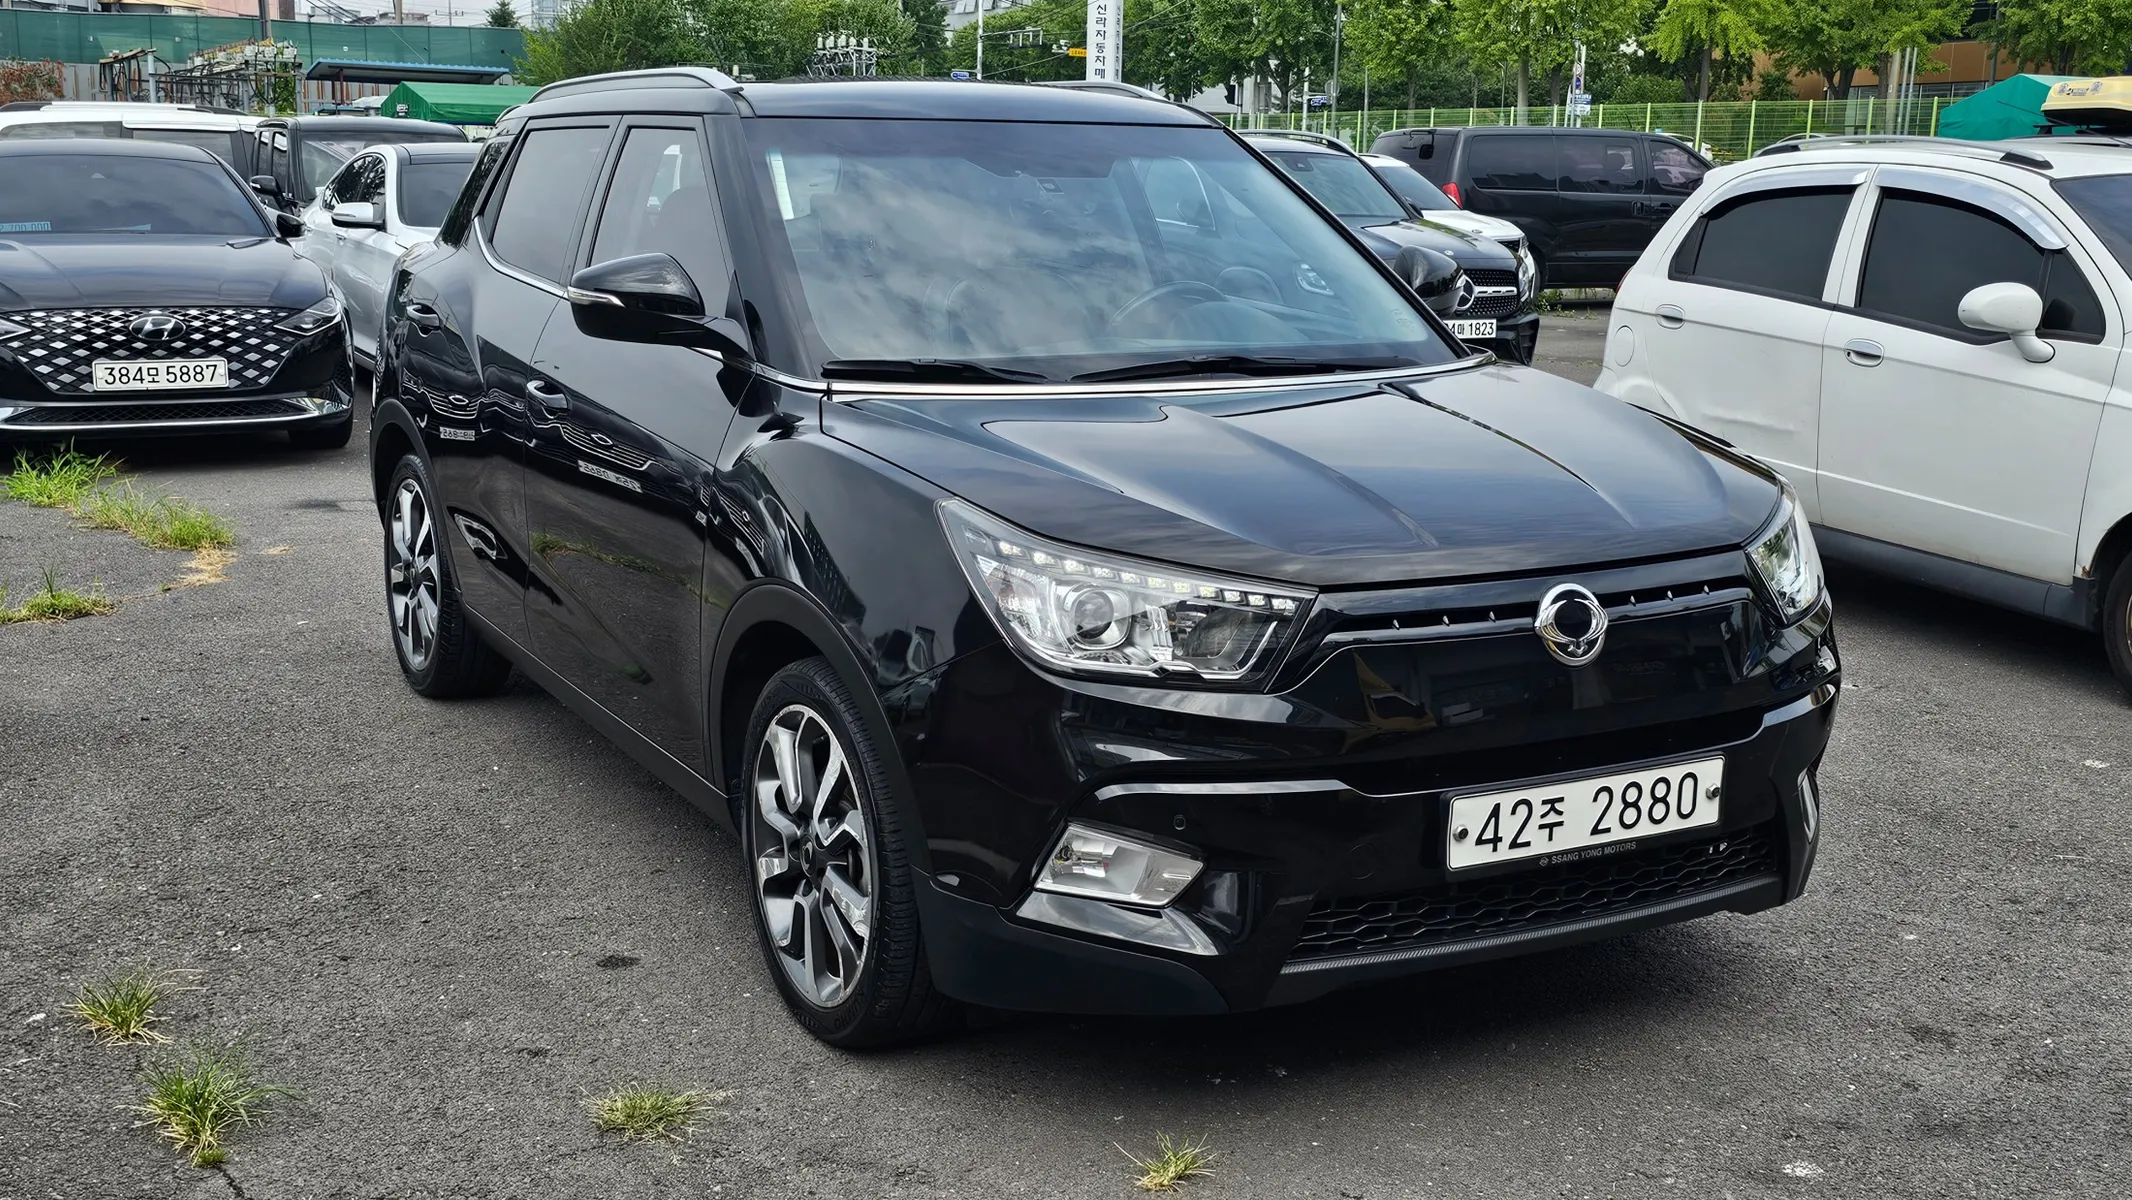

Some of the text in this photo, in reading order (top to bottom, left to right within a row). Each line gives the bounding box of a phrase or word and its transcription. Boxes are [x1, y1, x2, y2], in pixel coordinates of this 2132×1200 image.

[1469, 322, 1494, 336] 1823
[104, 364, 218, 385] 384모 5887
[1475, 771, 1698, 852] 42주 2880
[1551, 841, 1637, 864] SSANG YONG MOTORS
